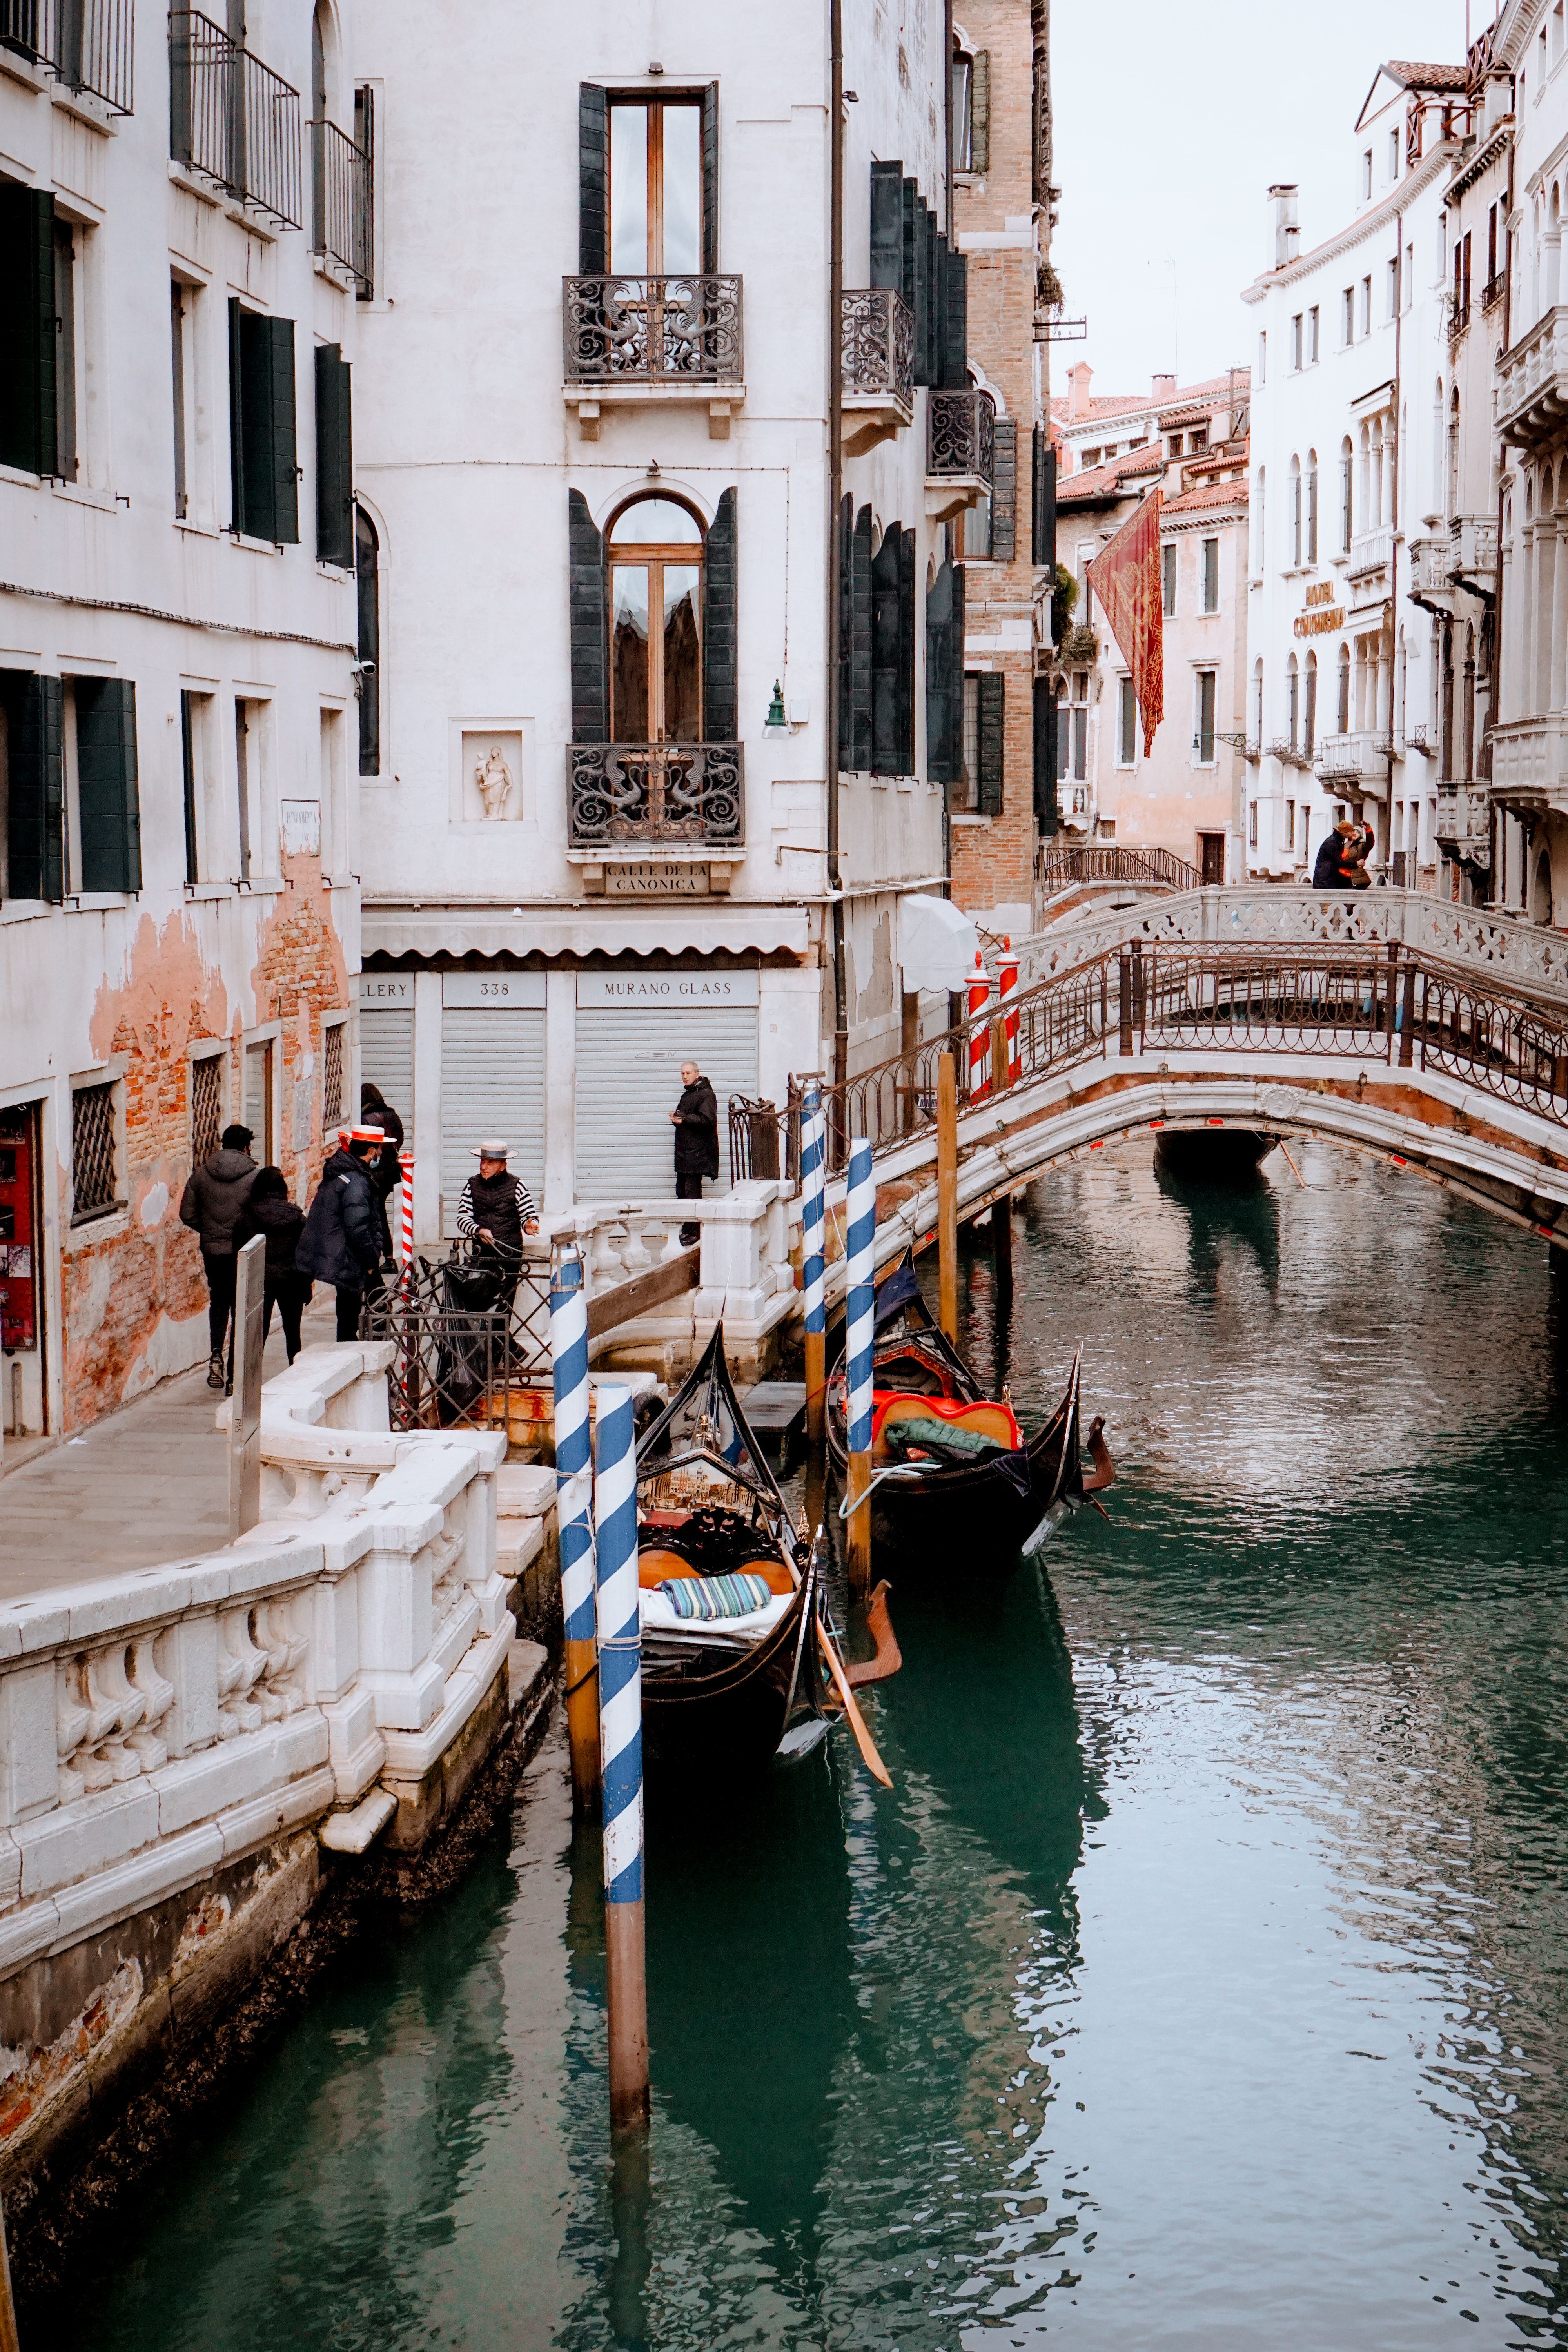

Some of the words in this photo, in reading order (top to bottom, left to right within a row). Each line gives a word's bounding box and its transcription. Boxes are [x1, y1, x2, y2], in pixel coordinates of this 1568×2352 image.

[608, 865, 657, 876] CALLE
[665, 865, 682, 876] DE
[690, 865, 706, 876] LA
[617, 879, 696, 890] CANONICA
[481, 984, 508, 995] 338
[605, 983, 670, 995] MURANO
[679, 983, 731, 995] GLASS
